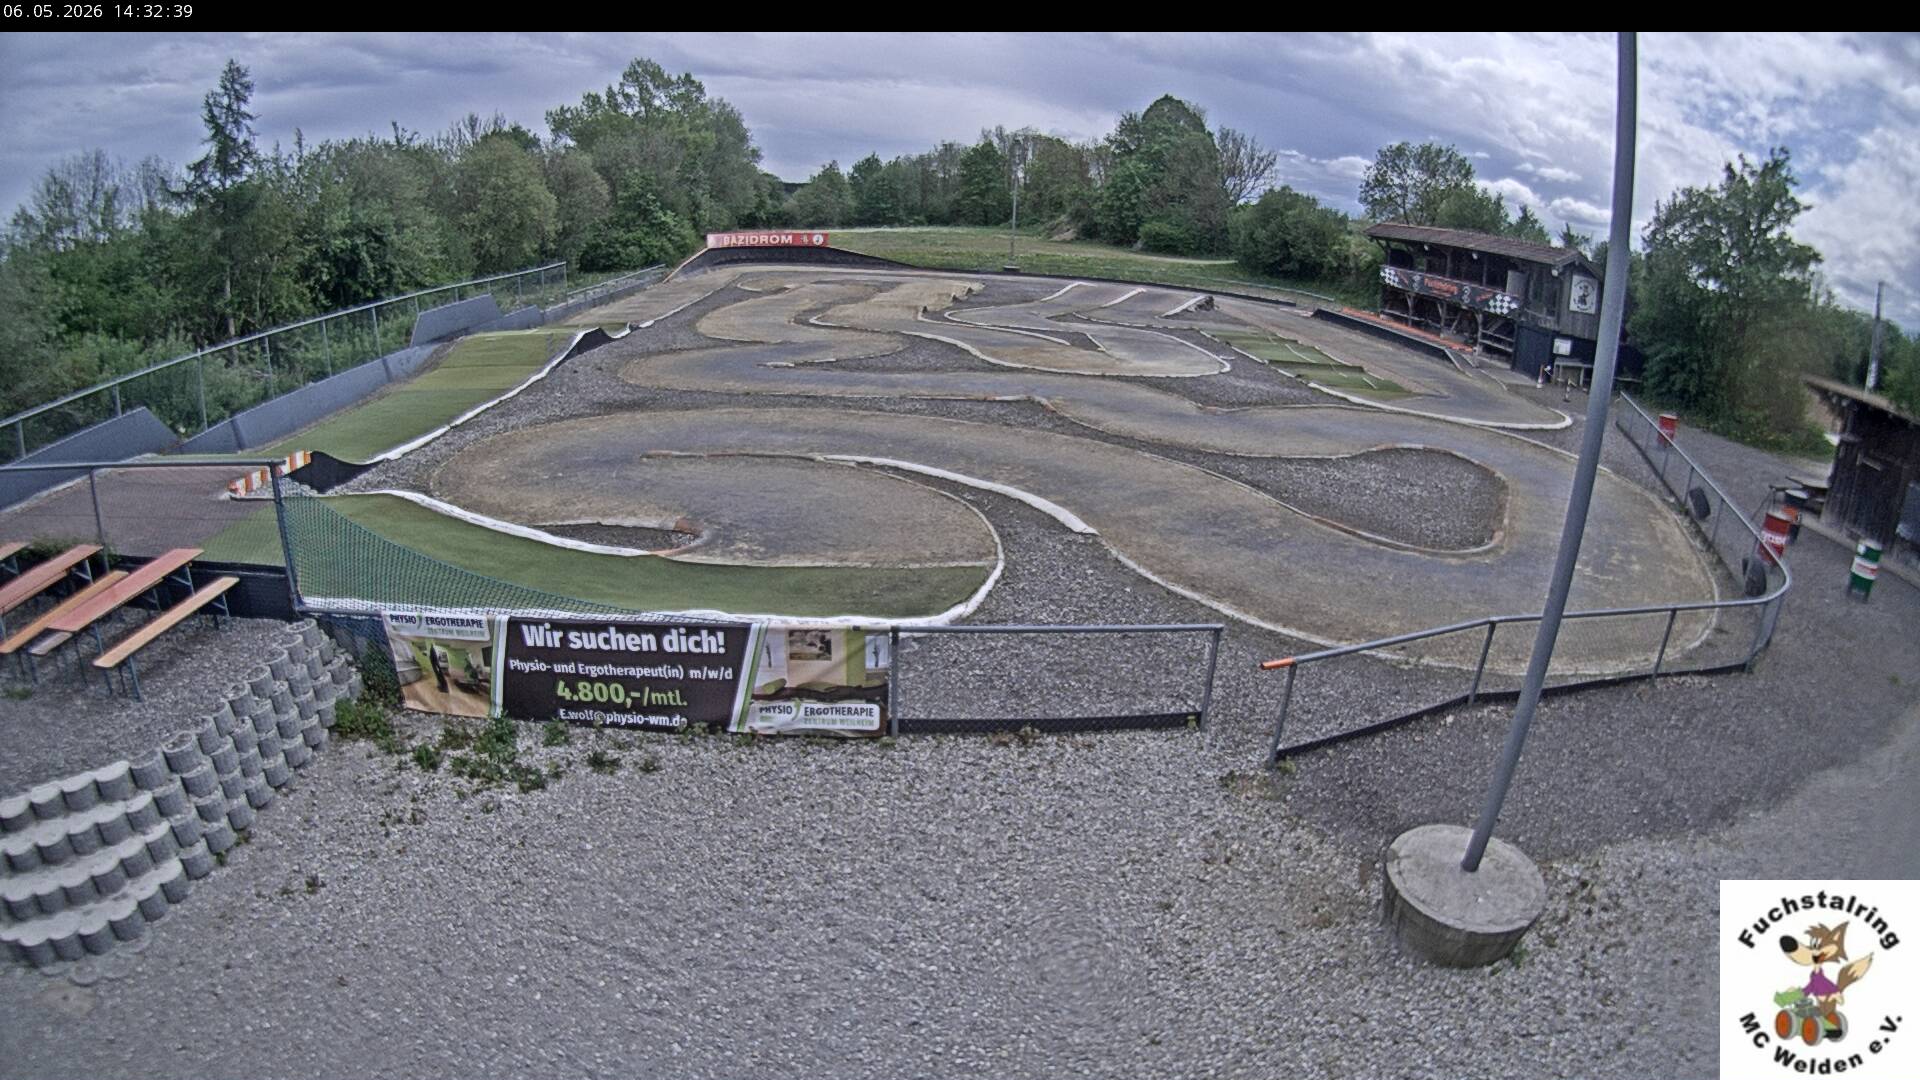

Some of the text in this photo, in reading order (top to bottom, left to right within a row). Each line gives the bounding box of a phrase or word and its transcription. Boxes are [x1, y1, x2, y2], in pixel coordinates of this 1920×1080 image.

[723, 234, 793, 246] BAZIDROM
[389, 613, 484, 629] PHYSIO ERGOTHERAPIE
[522, 623, 726, 654] Wir suchen dich!
[509, 658, 733, 681] Physio- und Ergotherapeut(in) m/w/d
[759, 704, 874, 717] PHYSIO ERGOTHERAPIE
